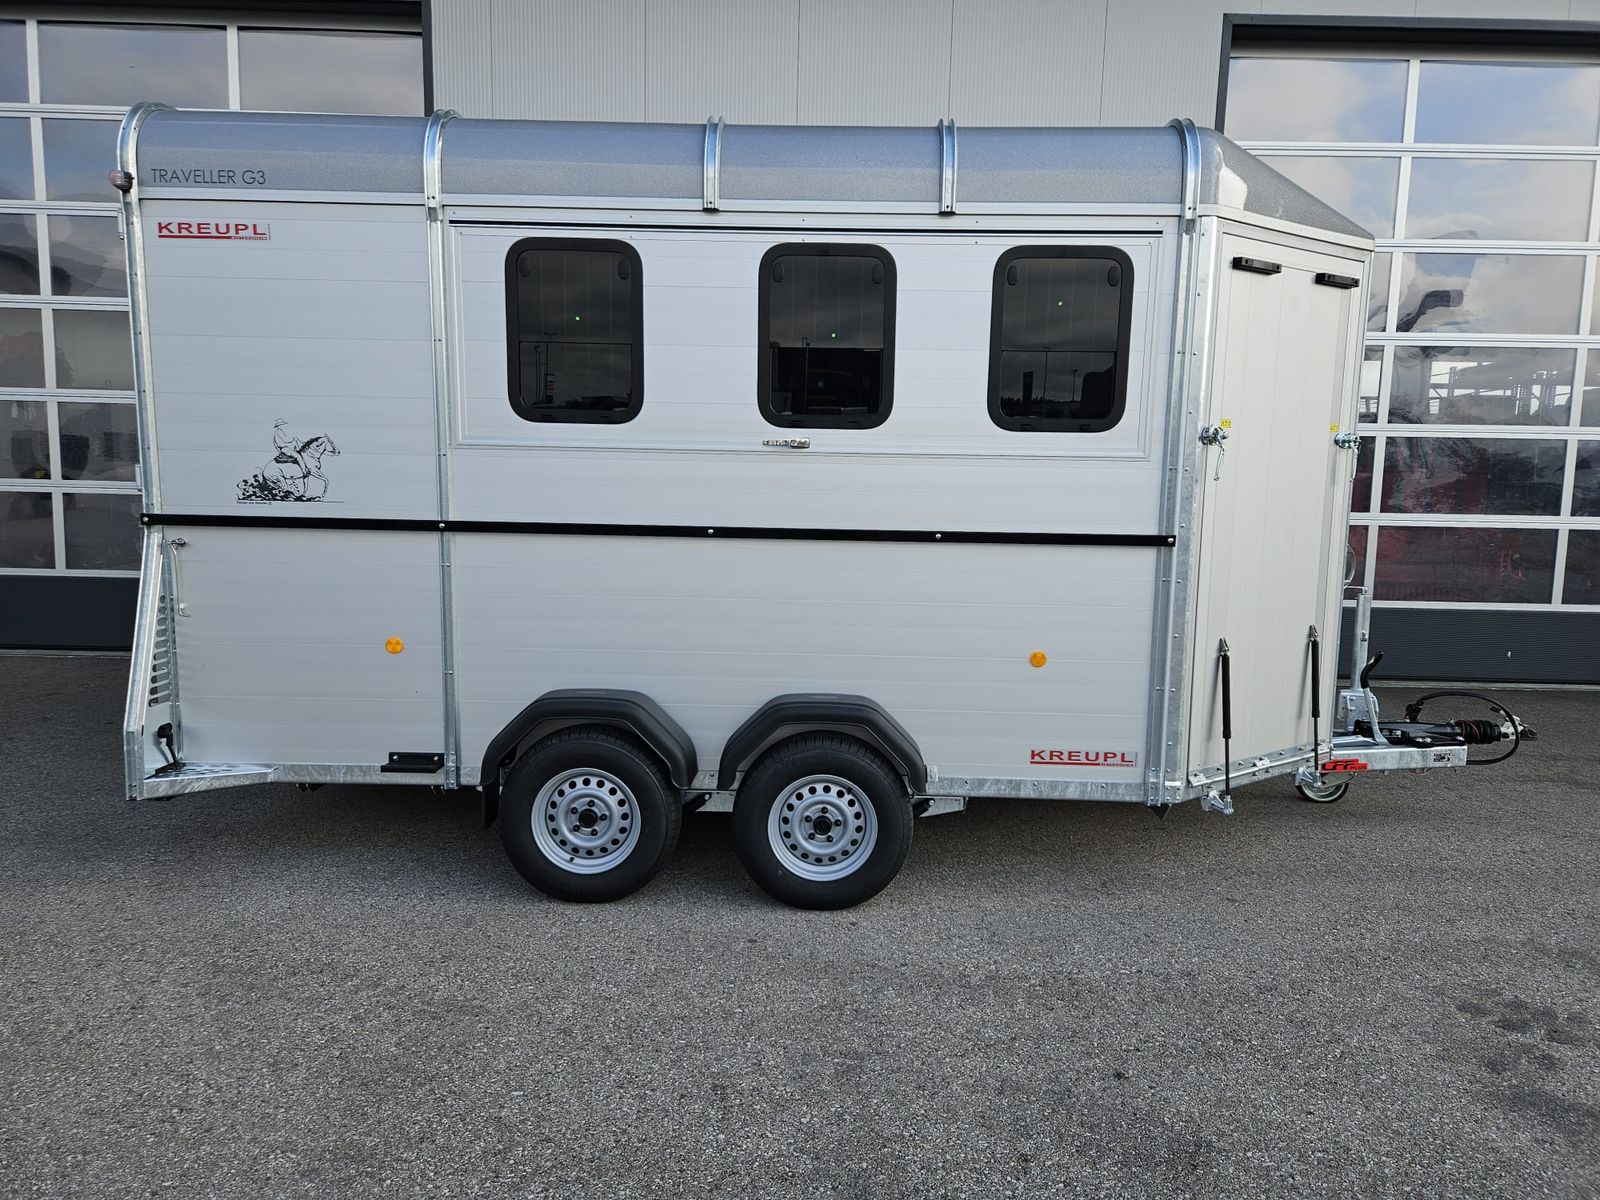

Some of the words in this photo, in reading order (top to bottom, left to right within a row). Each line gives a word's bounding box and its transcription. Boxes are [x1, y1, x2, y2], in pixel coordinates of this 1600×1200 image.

[151, 168, 236, 184] TRAVELLER
[241, 170, 266, 185] G3
[158, 222, 267, 236] KREUPL
[1030, 750, 1134, 763] KREUPL
